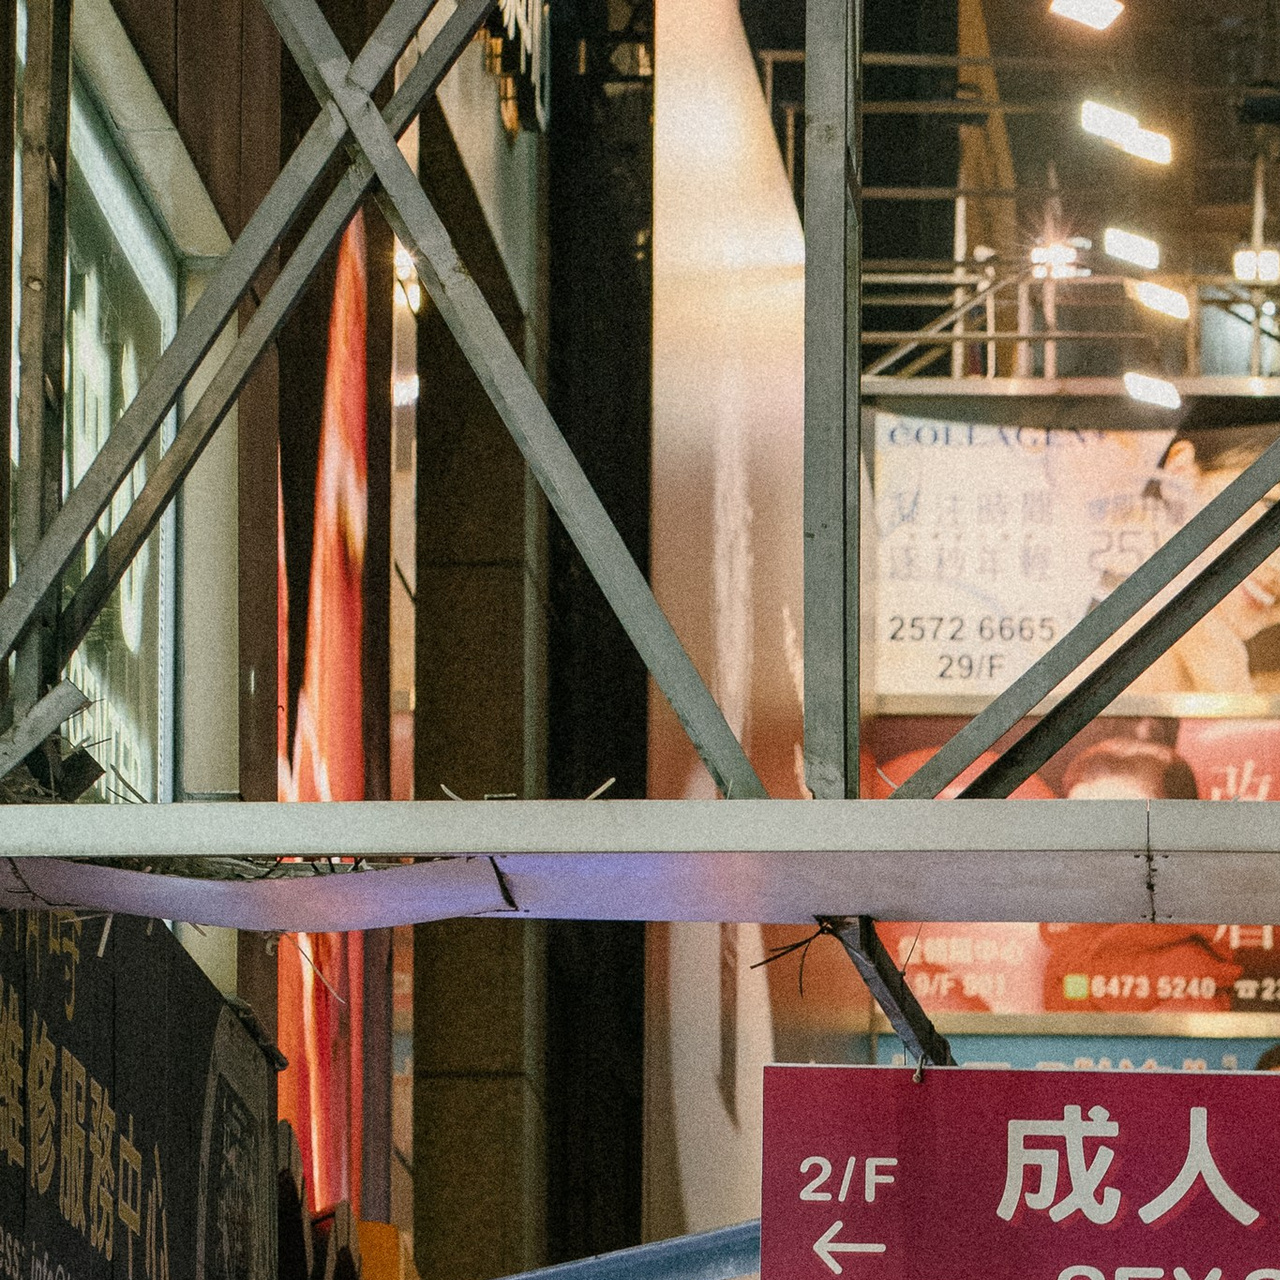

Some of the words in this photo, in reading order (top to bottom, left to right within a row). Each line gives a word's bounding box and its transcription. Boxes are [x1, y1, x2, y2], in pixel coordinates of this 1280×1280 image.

[889, 616, 965, 642] 2572
[978, 616, 1055, 642] 6665
[938, 653, 1006, 680] 29/F
[799, 1156, 899, 1203] 2/F
